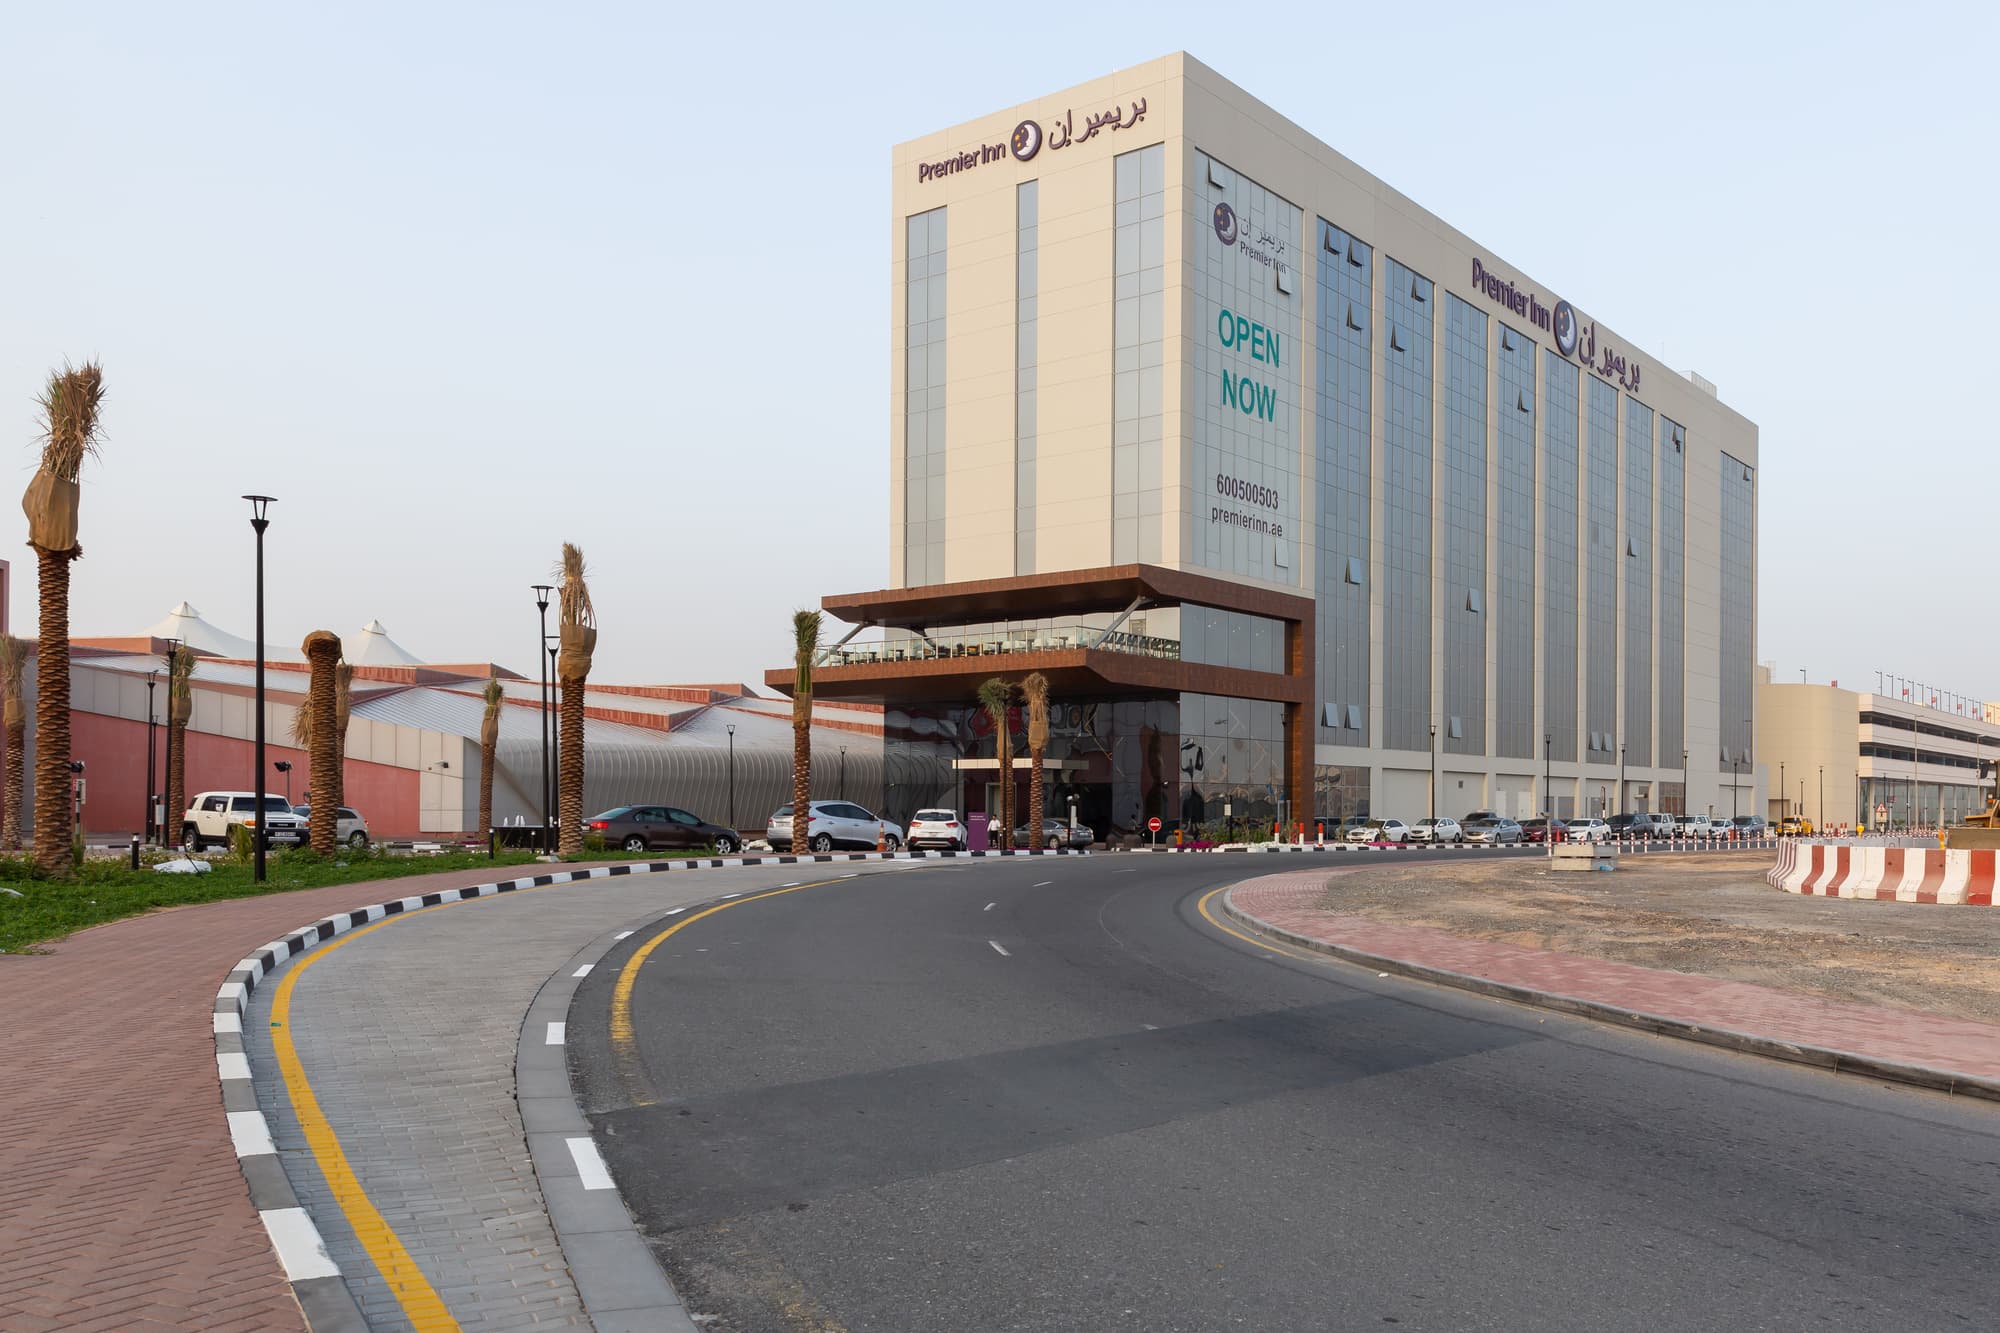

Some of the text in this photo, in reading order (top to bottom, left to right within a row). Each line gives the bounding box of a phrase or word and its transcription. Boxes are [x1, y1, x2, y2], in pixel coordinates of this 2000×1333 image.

[919, 143, 1006, 184] Premier Inn
[1240, 240, 1287, 275] Premier Inn
[1472, 257, 1551, 332] Premier Inn
[1218, 309, 1280, 368] OPEN
[1222, 368, 1277, 423] NOW
[1216, 473, 1279, 510] 600500503
[1211, 506, 1283, 537] premierinn.ae
